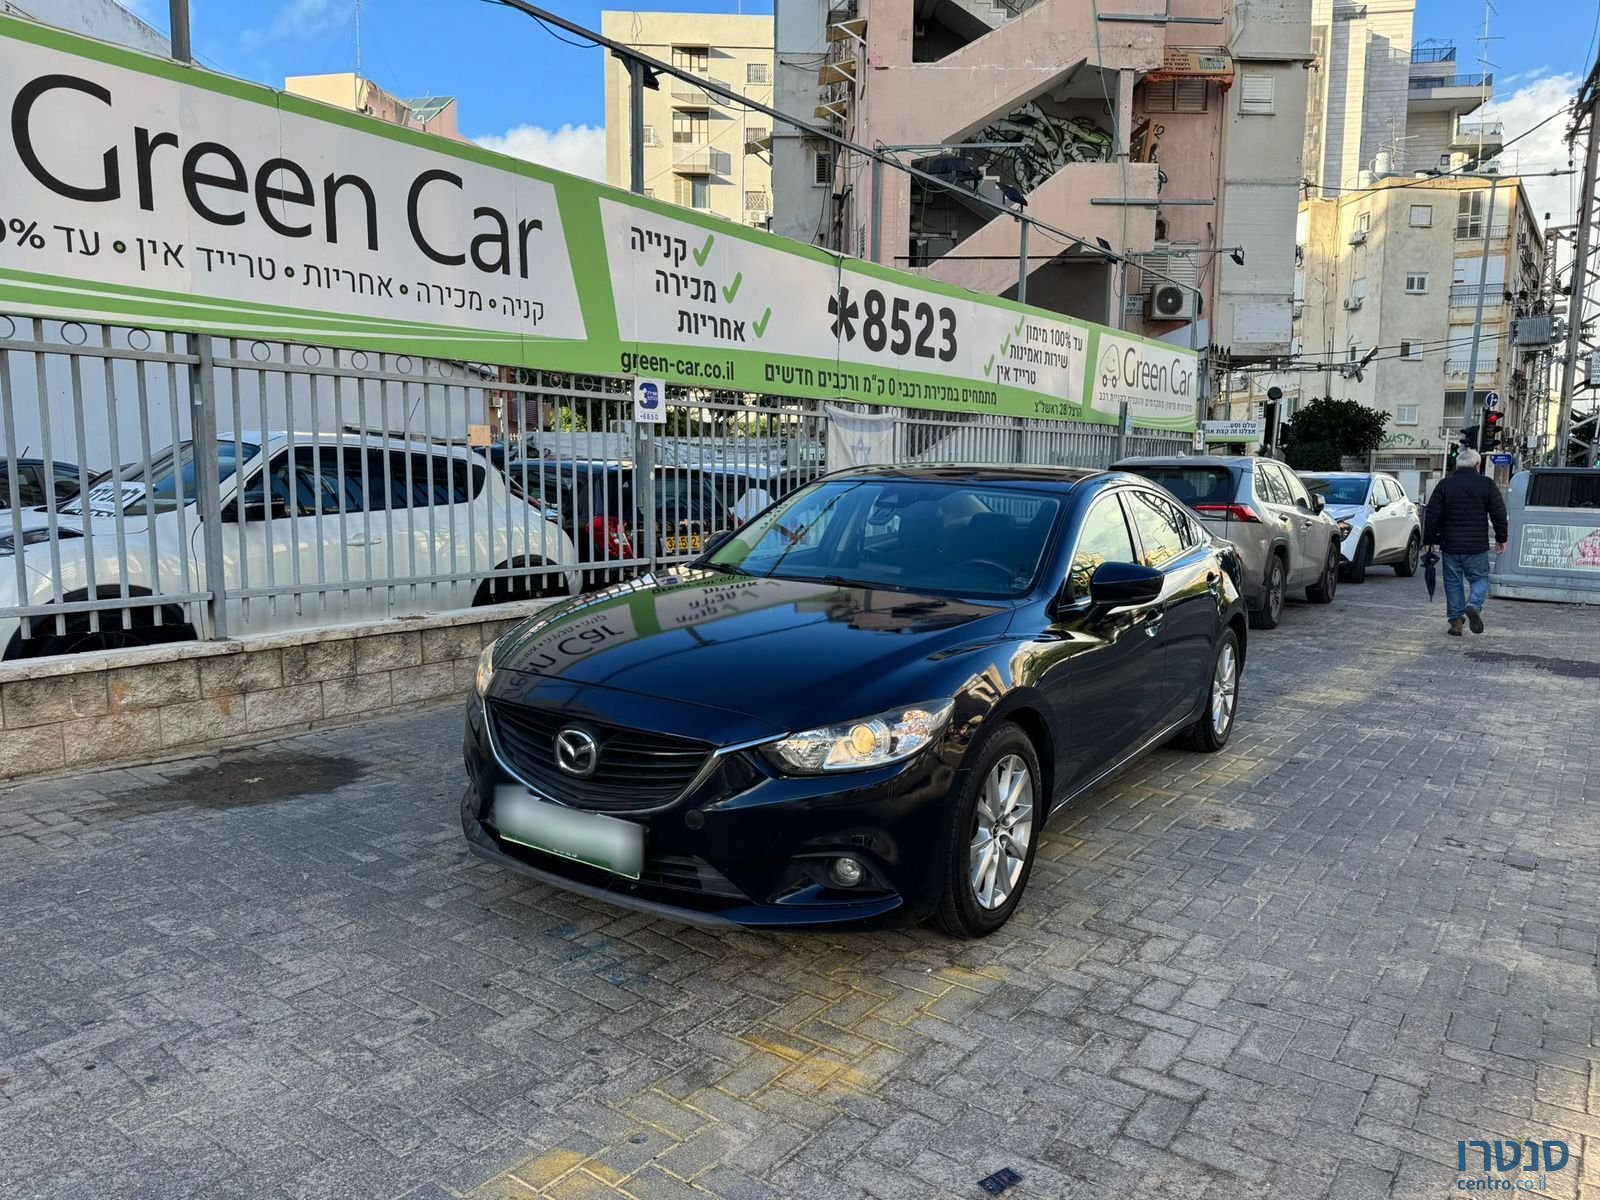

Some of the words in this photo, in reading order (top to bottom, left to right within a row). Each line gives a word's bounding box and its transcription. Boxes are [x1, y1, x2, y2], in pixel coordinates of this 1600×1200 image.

[11, 74, 378, 252] Green
[407, 169, 543, 279] Car
[53, 225, 101, 257] עד
[136, 236, 184, 272] אין
[630, 226, 688, 268] קנייה
[196, 245, 276, 281] טרייד
[302, 263, 393, 299] אחריות
[655, 269, 717, 304] מכירה
[416, 282, 483, 312] מכירה
[501, 295, 545, 325] קניה
[677, 309, 746, 343] אחריות
[1026, 324, 1048, 344] מימון
[1050, 329, 1071, 350] 100%
[1010, 344, 1042, 364] ואמינות
[1073, 336, 1083, 352] עד
[620, 351, 735, 381] green-car.co.il
[1044, 351, 1069, 369] שירות
[1123, 347, 1167, 393] Green
[1170, 358, 1193, 397] Car
[764, 363, 814, 387] חדשים
[818, 371, 859, 391] ורכבים
[997, 364, 1010, 385] אין
[1013, 367, 1036, 385] טרייד
[899, 381, 922, 398] רכבי
[923, 384, 959, 402] במכירת
[962, 390, 997, 406] מתמחים
